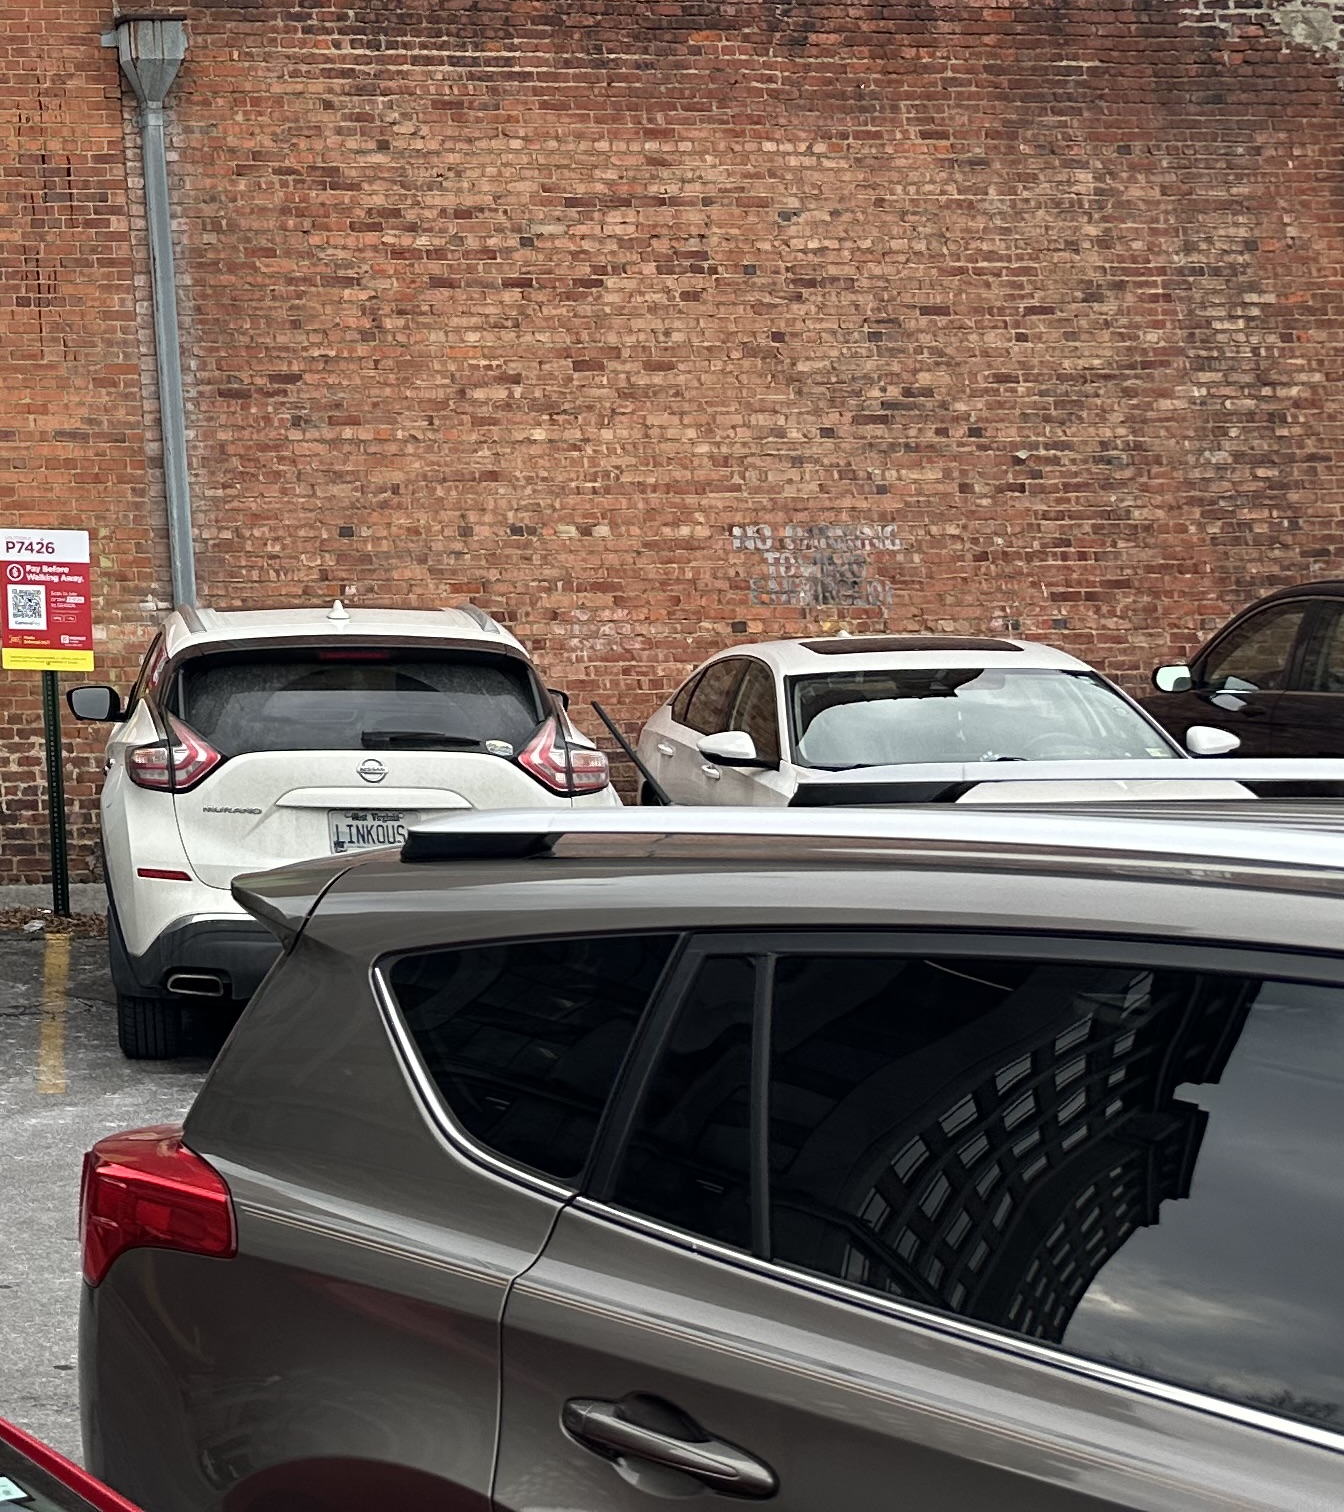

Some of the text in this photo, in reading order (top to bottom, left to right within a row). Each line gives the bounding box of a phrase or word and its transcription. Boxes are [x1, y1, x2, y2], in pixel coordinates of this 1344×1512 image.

[732, 524, 773, 550] NO
[5, 541, 55, 554] P7426
[25, 564, 70, 573] Pay Before
[25, 573, 59, 583] Walking
[334, 823, 407, 845] LINKOUS
